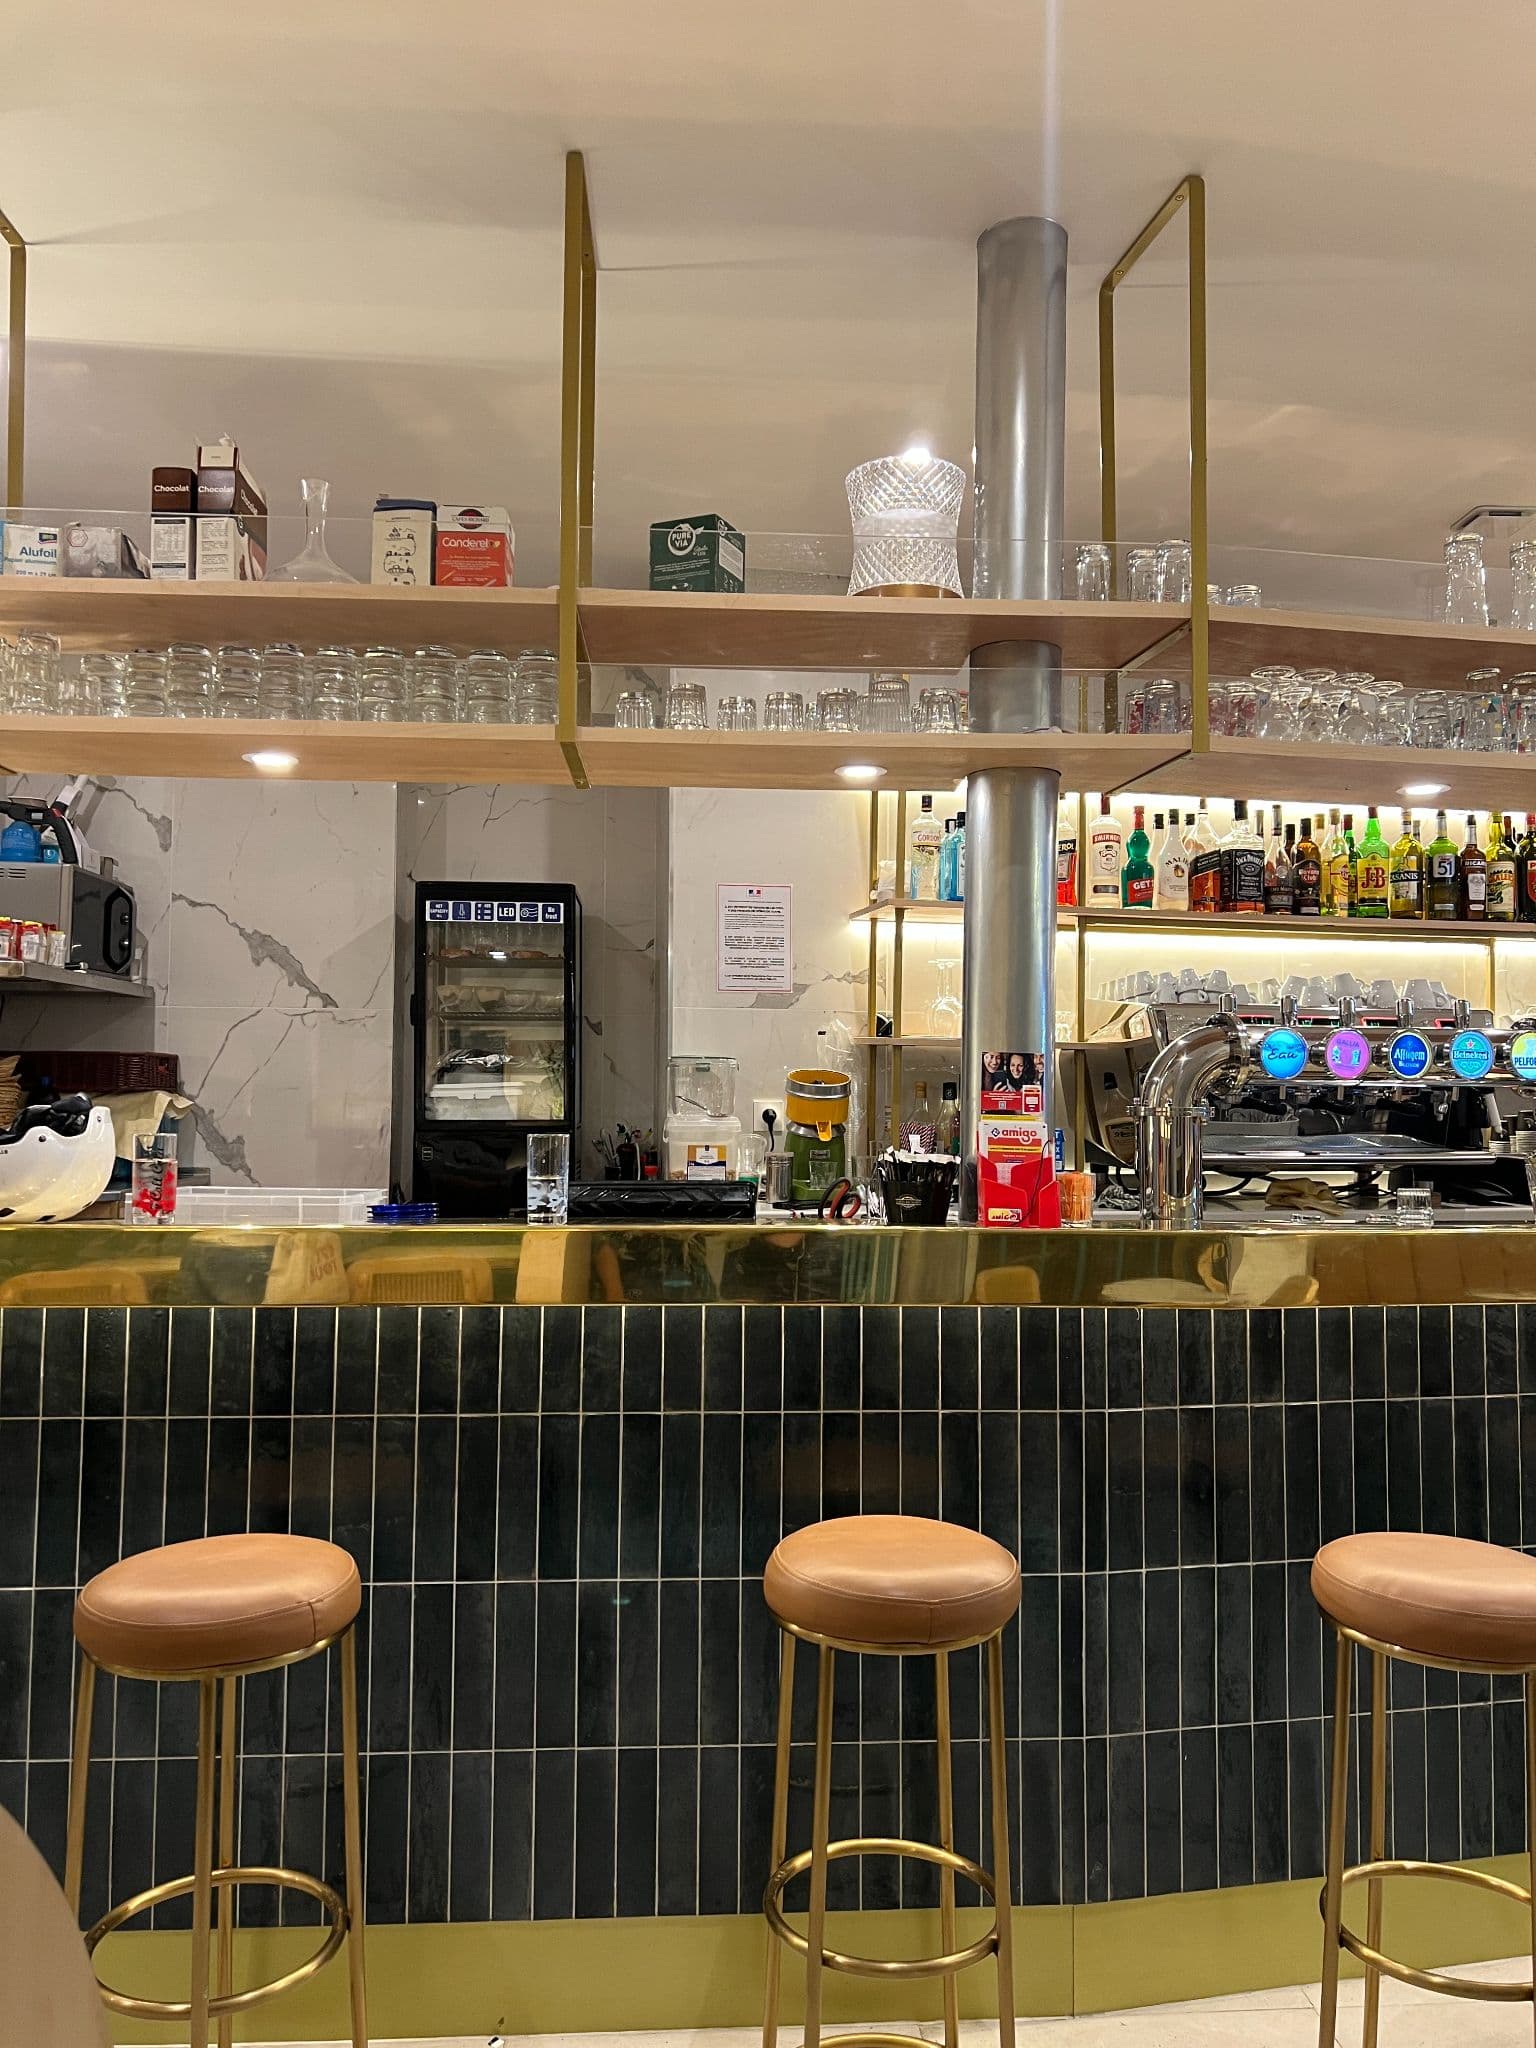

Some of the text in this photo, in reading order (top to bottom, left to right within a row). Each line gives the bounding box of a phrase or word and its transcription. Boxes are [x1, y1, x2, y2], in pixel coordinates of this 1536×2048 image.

[153, 484, 190, 493] Chocolat
[197, 485, 235, 494] Chocolat
[672, 530, 693, 541] PURE
[441, 536, 489, 548] Canderel
[674, 539, 689, 548] VIA
[19, 545, 57, 559] Alufoil
[1057, 843, 1075, 851] EROL
[1437, 861, 1453, 875] 51
[1303, 874, 1317, 882] Club
[1361, 866, 1385, 888] J&B
[1132, 880, 1150, 890] GET
[498, 906, 515, 917] LED
[1267, 1048, 1299, 1061] Eau
[1453, 1050, 1489, 1060] Heineken
[1001, 1126, 1038, 1144] amigo
